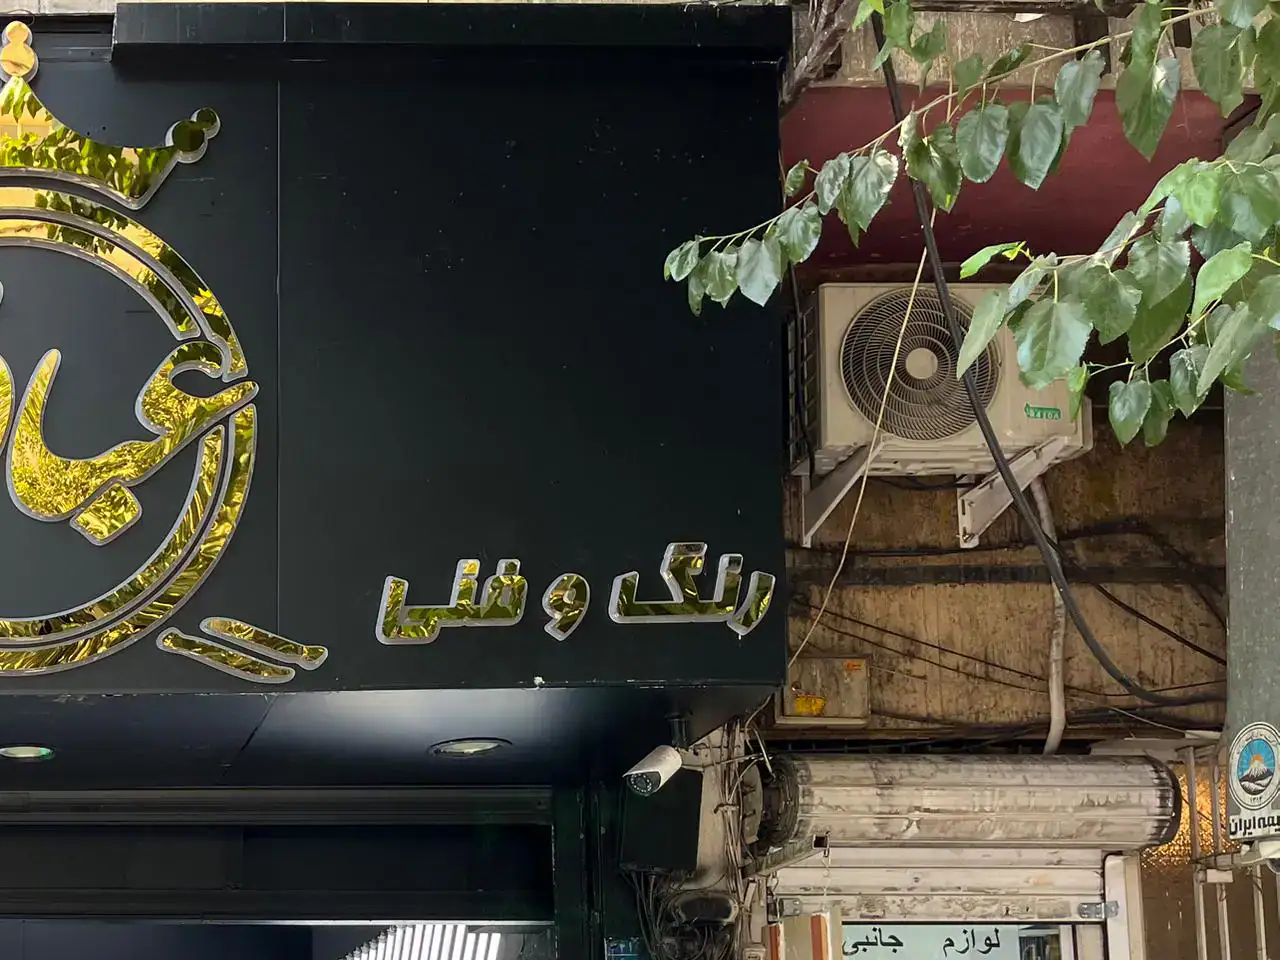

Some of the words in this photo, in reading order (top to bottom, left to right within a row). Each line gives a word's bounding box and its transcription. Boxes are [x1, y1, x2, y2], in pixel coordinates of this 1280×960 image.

[375, 558, 527, 645] فنی
[542, 573, 591, 641] و
[608, 542, 775, 636] رنگ
[1229, 816, 1256, 836] ایران
[841, 927, 904, 956] جانبی
[943, 928, 1001, 957] لوازم
